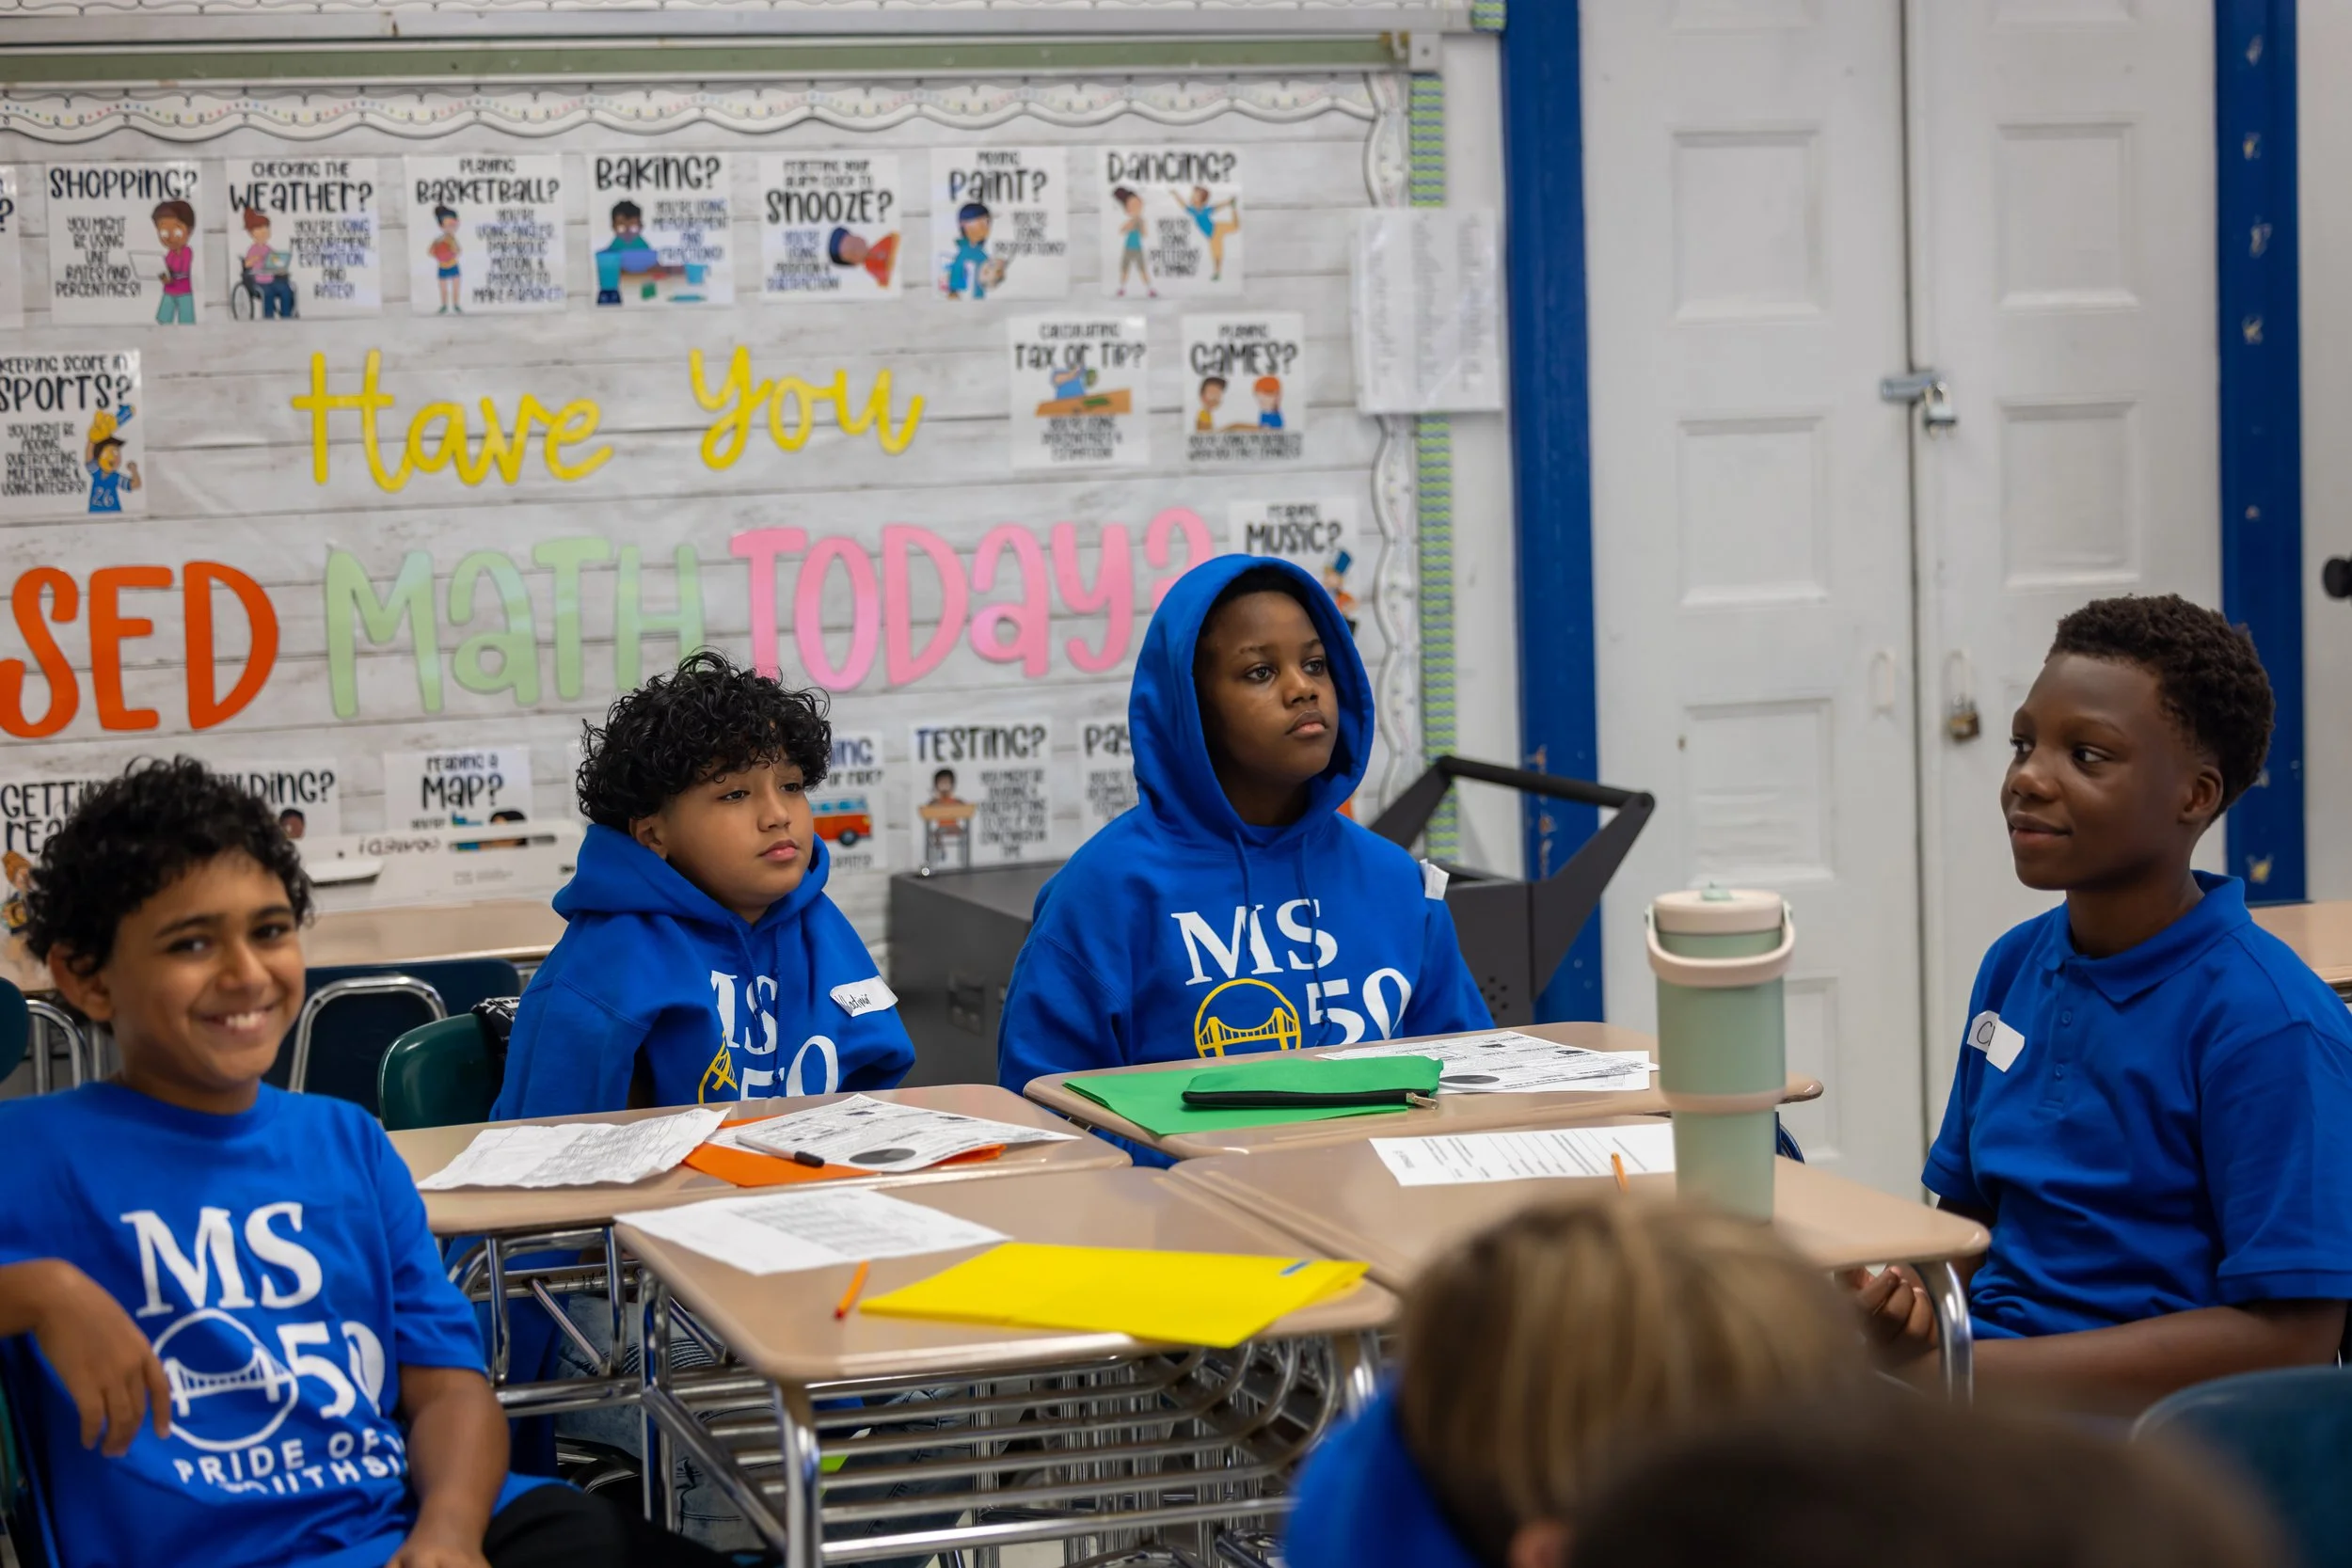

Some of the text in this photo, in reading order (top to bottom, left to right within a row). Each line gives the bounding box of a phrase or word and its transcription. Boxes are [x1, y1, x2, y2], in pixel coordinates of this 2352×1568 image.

[292, 344, 926, 492] Have you
[1169, 897, 1339, 986] MS
[119, 1201, 324, 1319] MS
